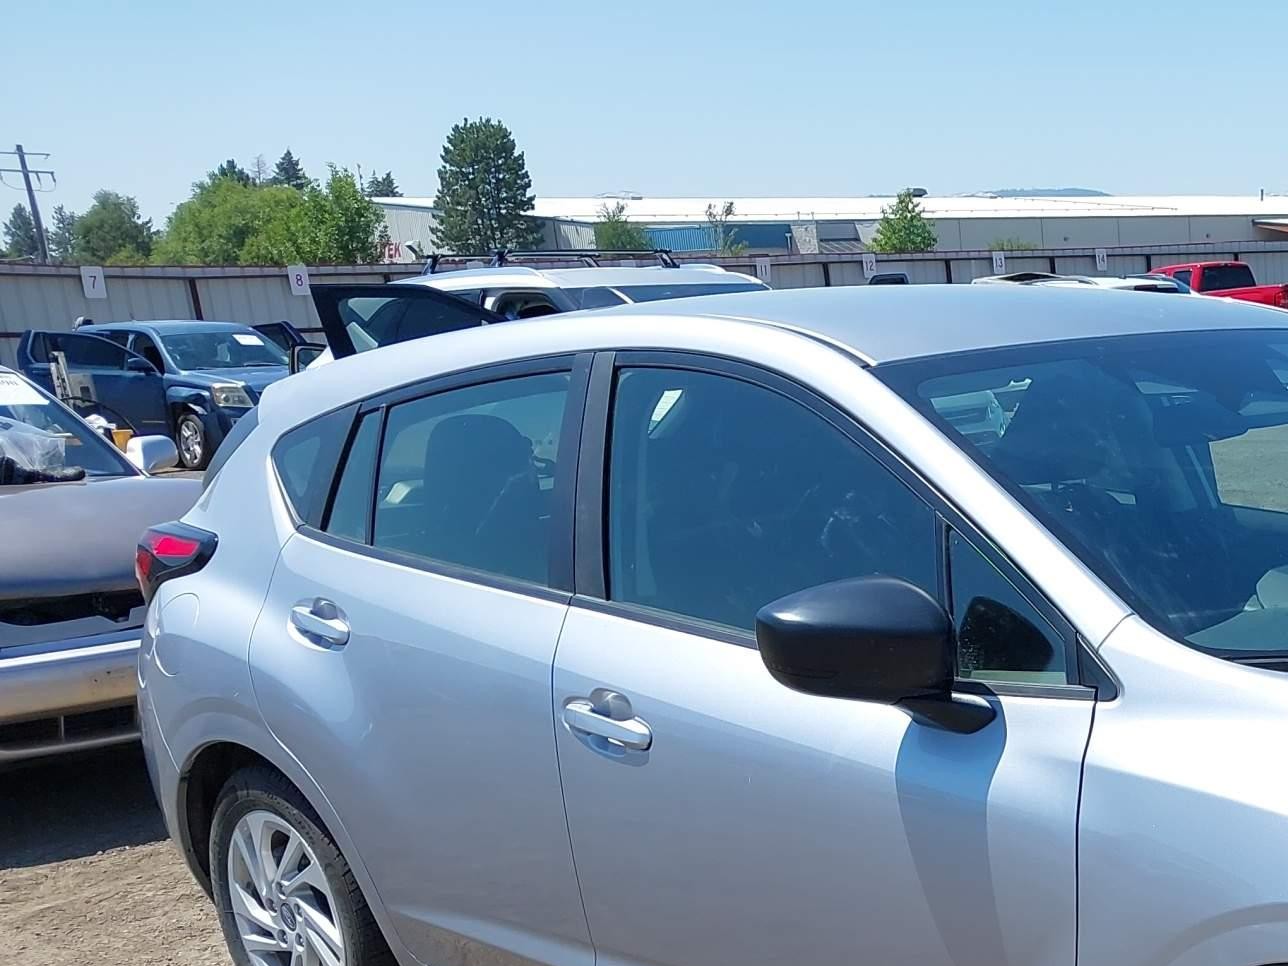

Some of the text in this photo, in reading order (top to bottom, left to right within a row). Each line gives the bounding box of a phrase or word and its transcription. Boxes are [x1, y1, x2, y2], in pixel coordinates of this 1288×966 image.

[760, 263, 768, 277] 11
[865, 260, 874, 272] 12
[88, 275, 97, 289] 7
[295, 273, 304, 287] 8
